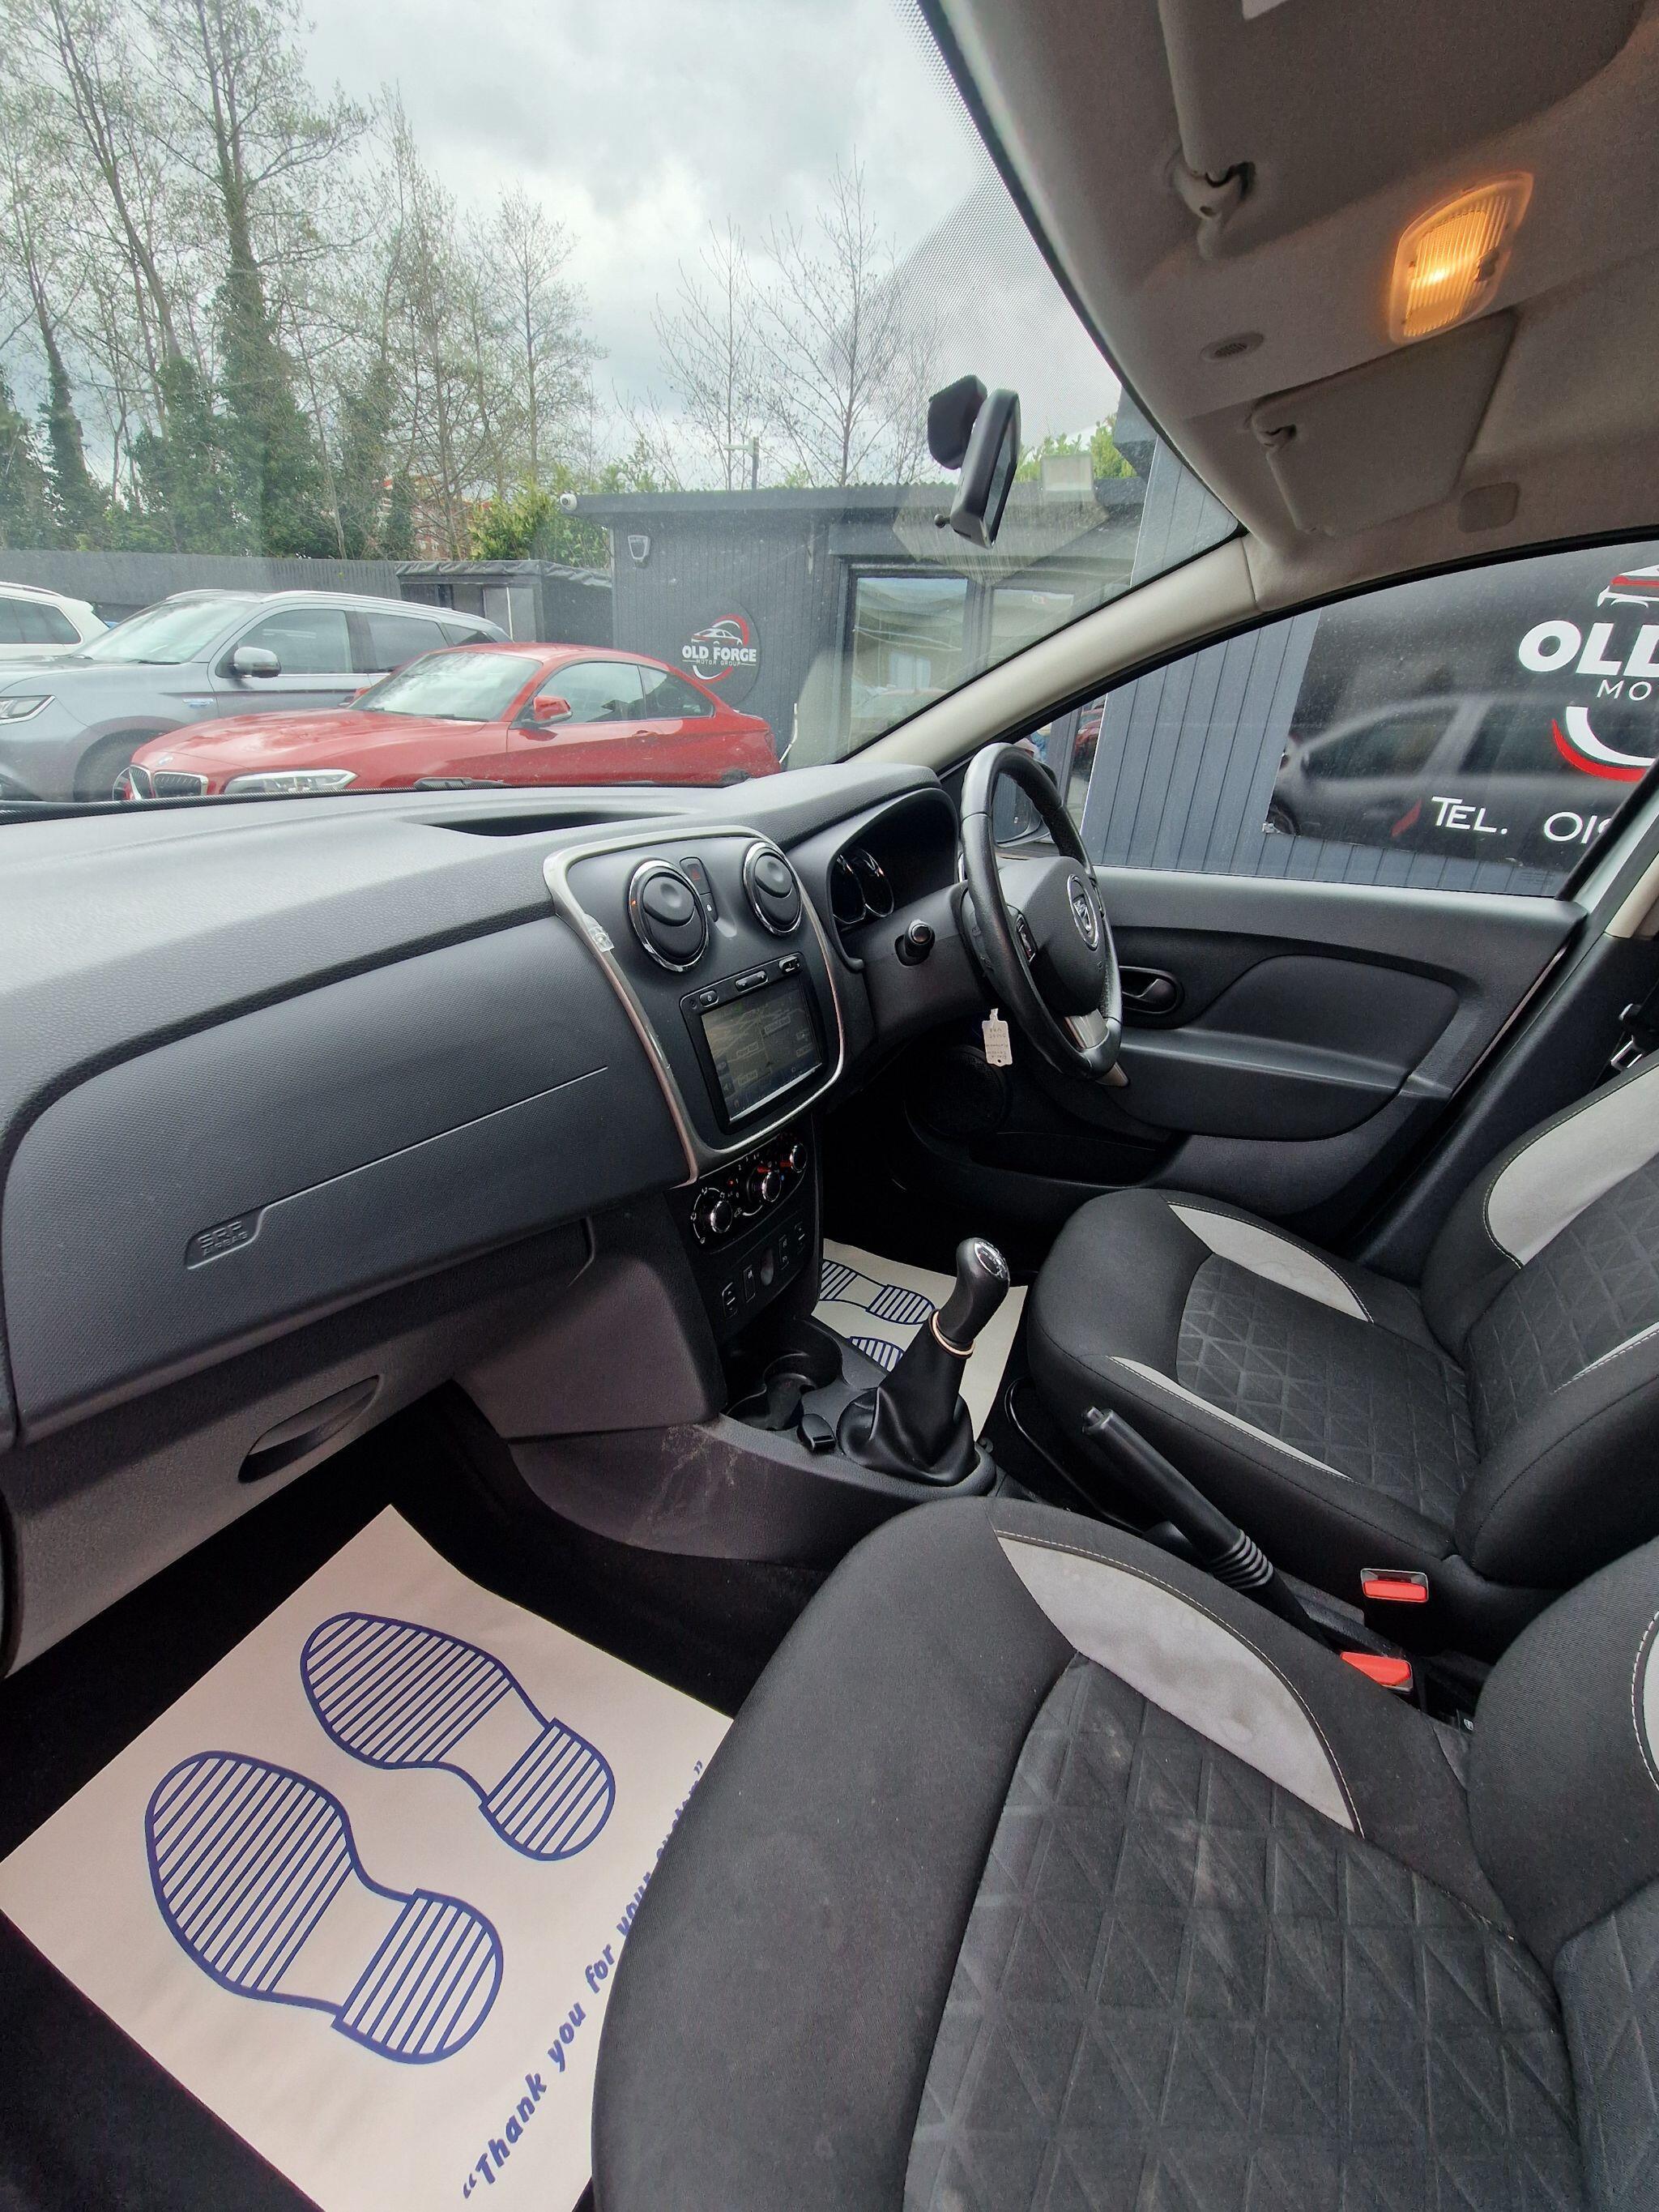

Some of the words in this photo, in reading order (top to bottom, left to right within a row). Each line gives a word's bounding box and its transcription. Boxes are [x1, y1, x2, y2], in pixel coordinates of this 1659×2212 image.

[682, 645, 709, 660] OLD
[713, 647, 757, 662] FORGE
[547, 2003, 586, 2073] you
[584, 1944, 616, 1994] for
